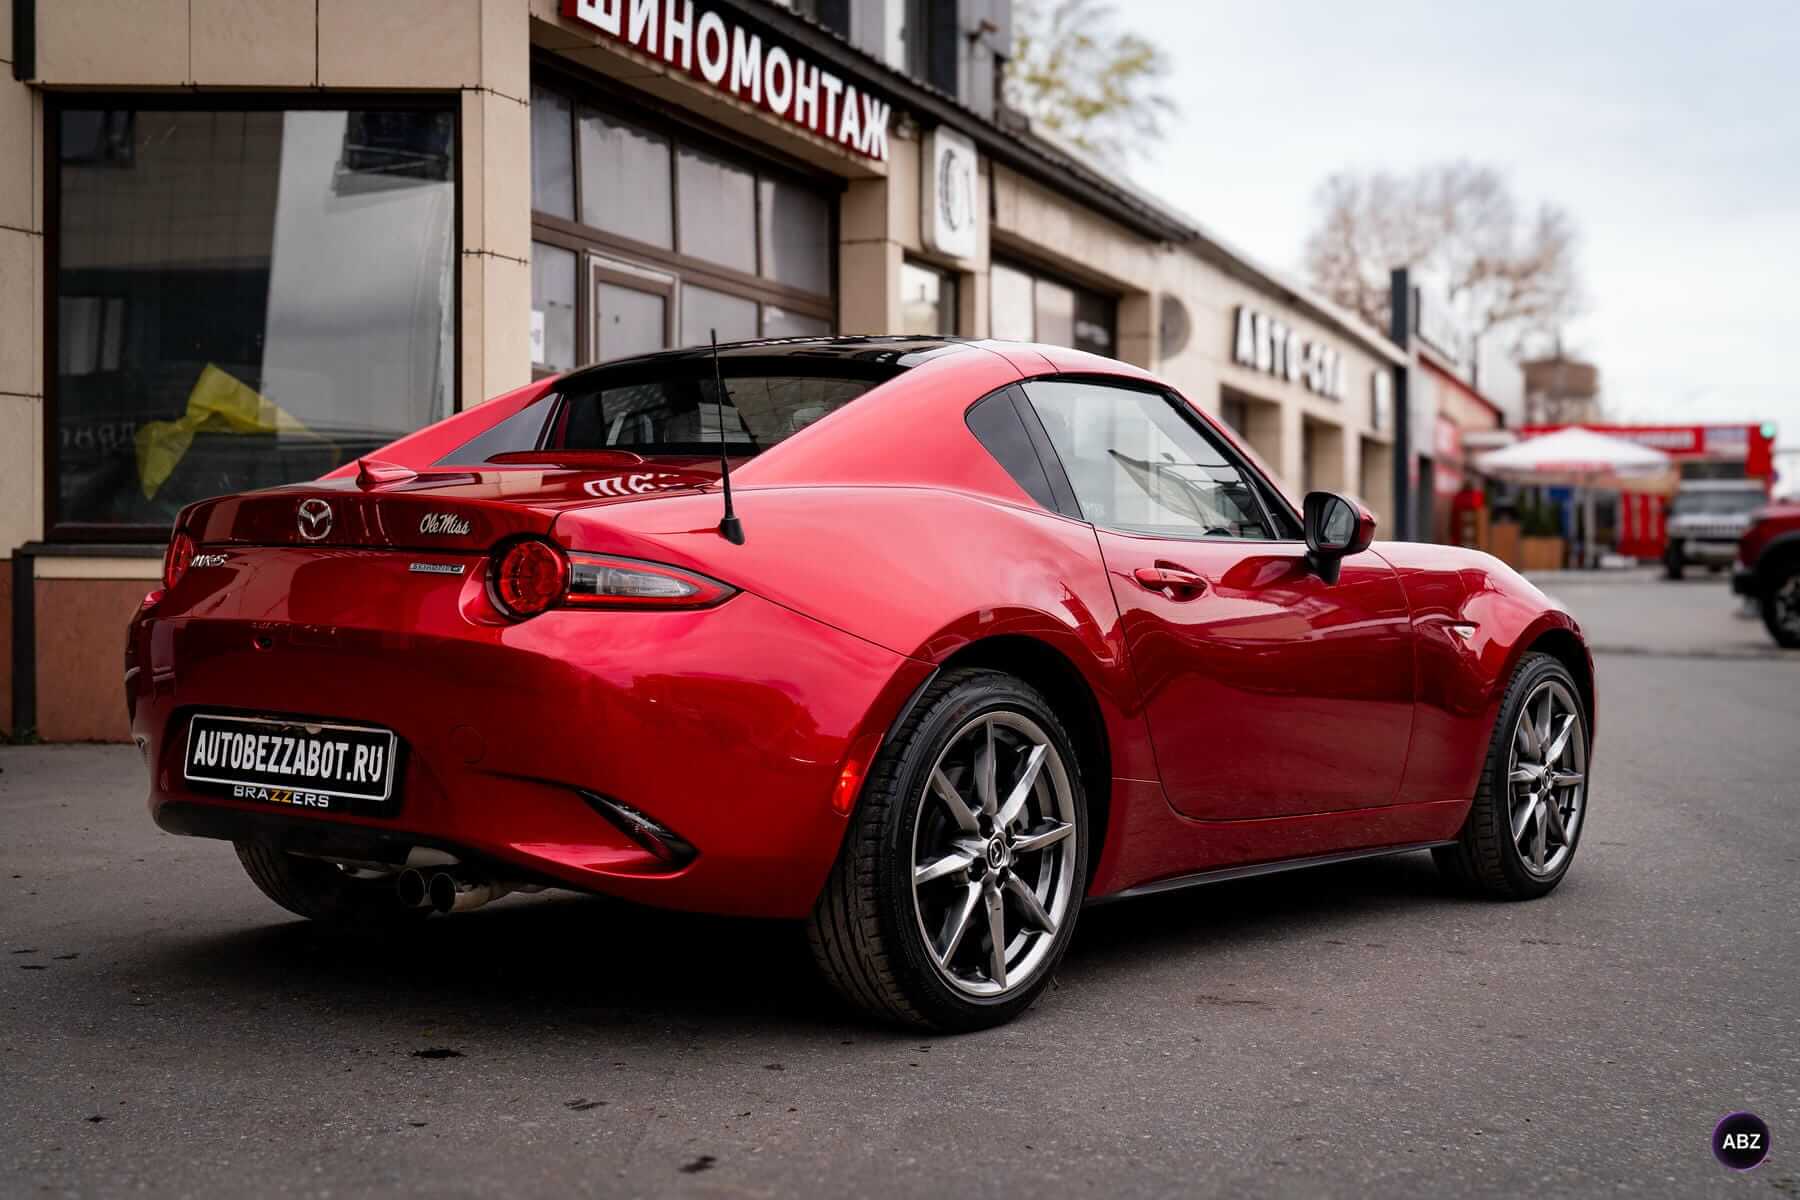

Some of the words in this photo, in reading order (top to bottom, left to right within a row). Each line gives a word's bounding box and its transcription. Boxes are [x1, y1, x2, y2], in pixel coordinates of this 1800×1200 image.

[439, 512, 471, 535] Miss
[193, 730, 384, 783] AUTOBEZZABOT.RU
[233, 785, 330, 808] BRAZZERS
